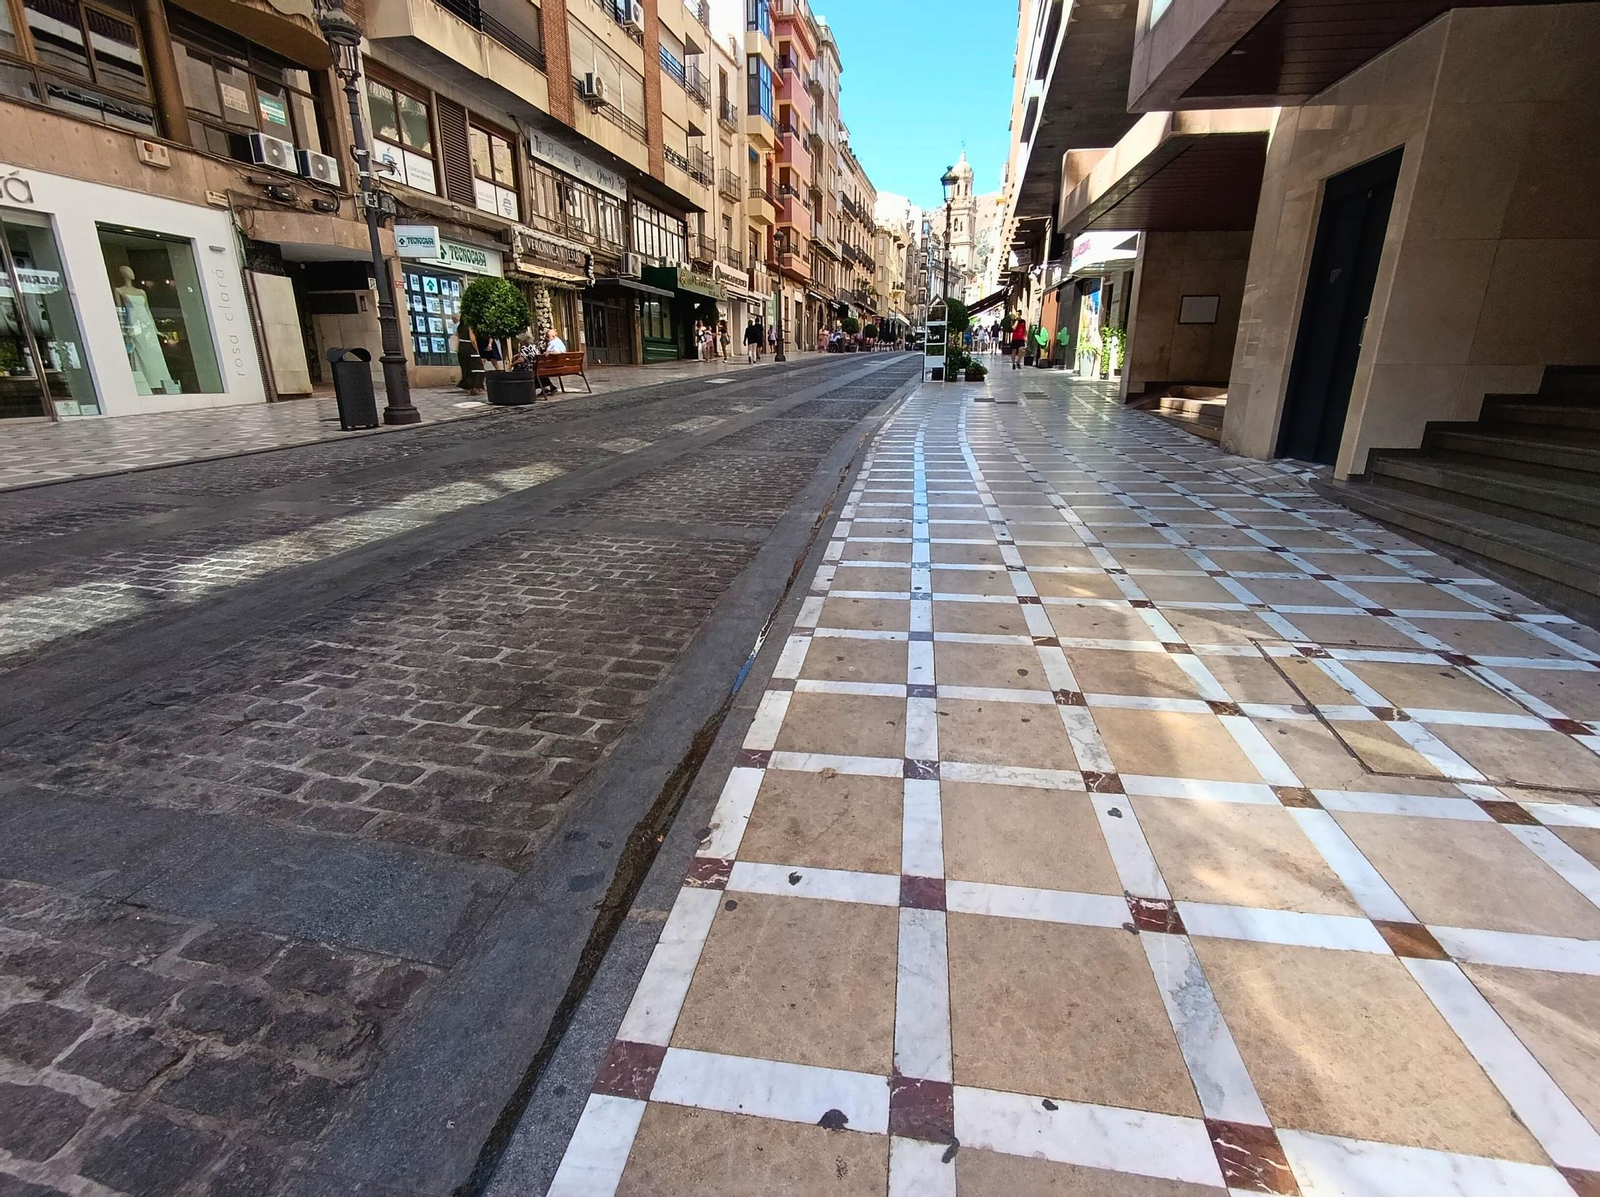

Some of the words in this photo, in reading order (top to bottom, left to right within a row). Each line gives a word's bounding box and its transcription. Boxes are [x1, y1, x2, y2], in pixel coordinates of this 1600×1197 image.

[406, 236, 434, 245] TECNOCASA
[448, 245, 487, 267] TECNOCASA
[211, 268, 234, 322] clará
[230, 335, 246, 377] rosa
